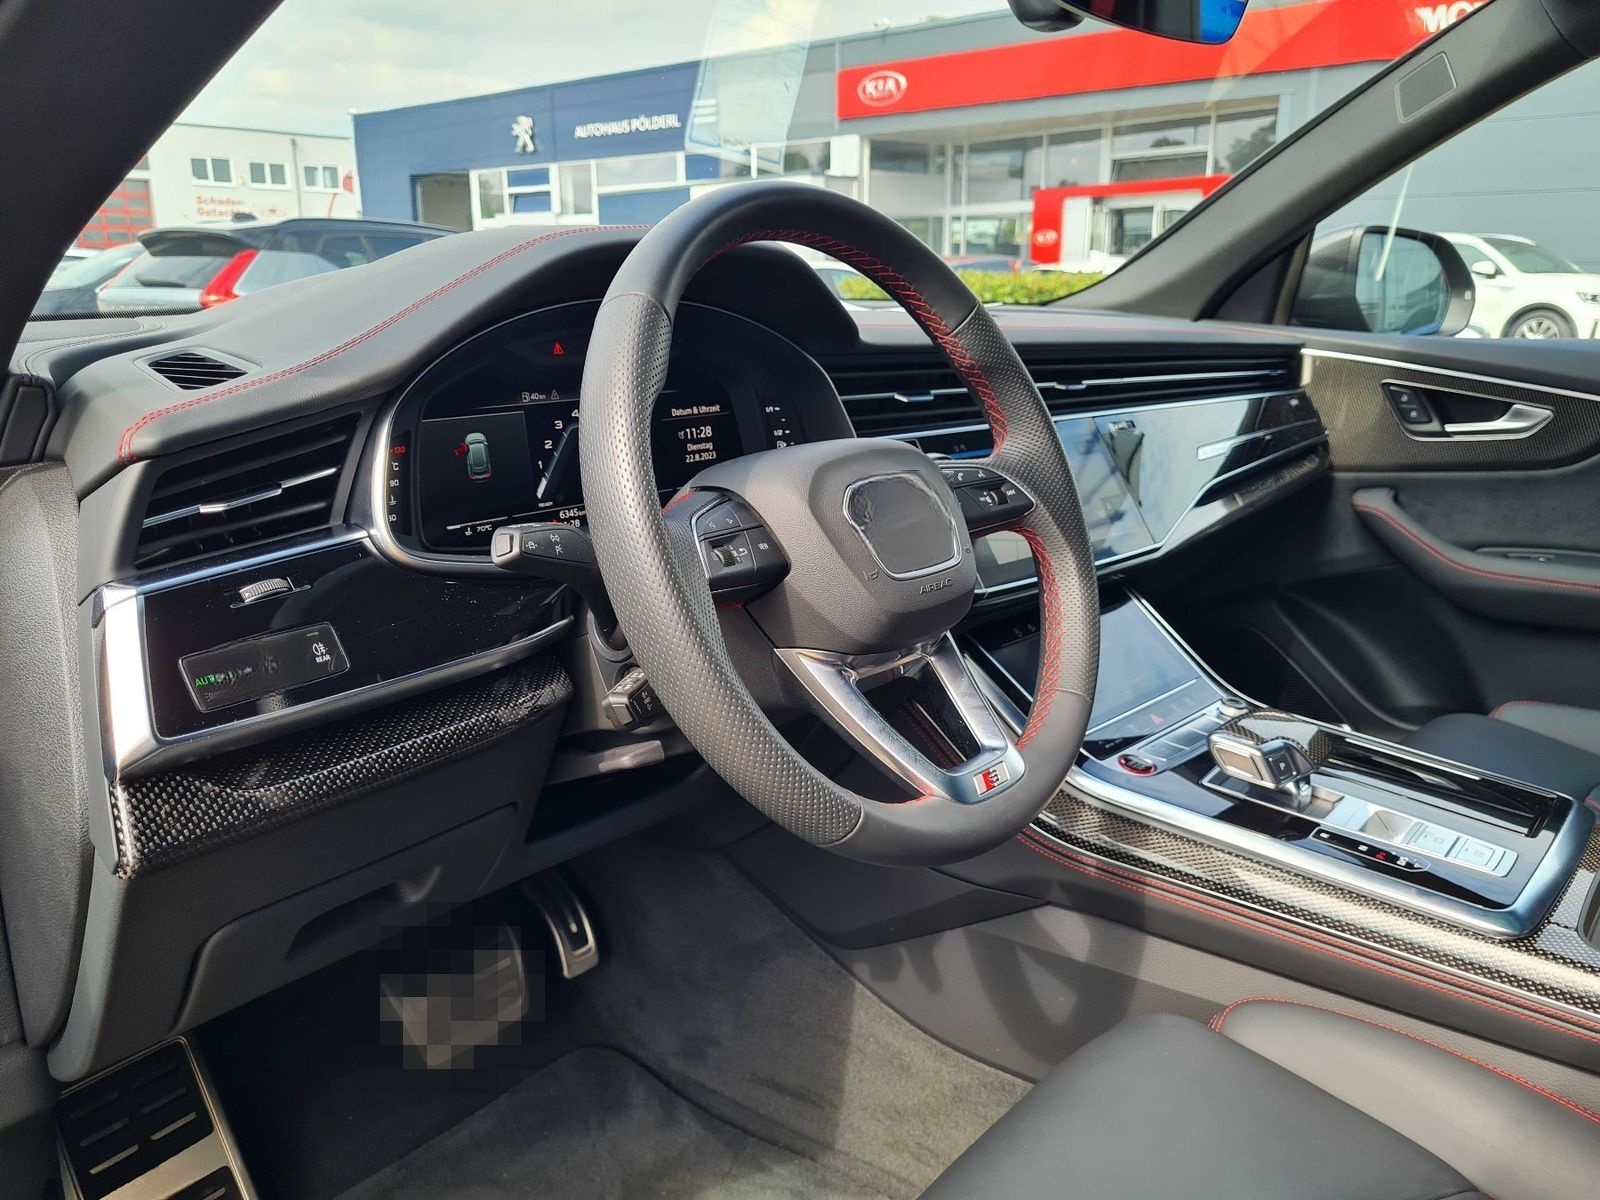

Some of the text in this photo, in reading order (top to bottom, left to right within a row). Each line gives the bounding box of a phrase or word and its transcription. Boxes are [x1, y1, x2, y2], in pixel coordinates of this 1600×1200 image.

[1414, 1, 1488, 33] MO
[574, 114, 681, 139] AUTOHAUS PÖLDERL
[571, 408, 580, 417] 4
[671, 404, 720, 417] Datum & Uhrzeit
[554, 420, 563, 429] 3
[685, 425, 713, 440] 11:28
[544, 440, 553, 449] 2
[686, 442, 713, 452] Dienstag
[685, 451, 717, 463] 22.8.2023
[537, 460, 543, 469] 1
[919, 578, 953, 594] AIRBAG
[315, 655, 332, 663] REAR
